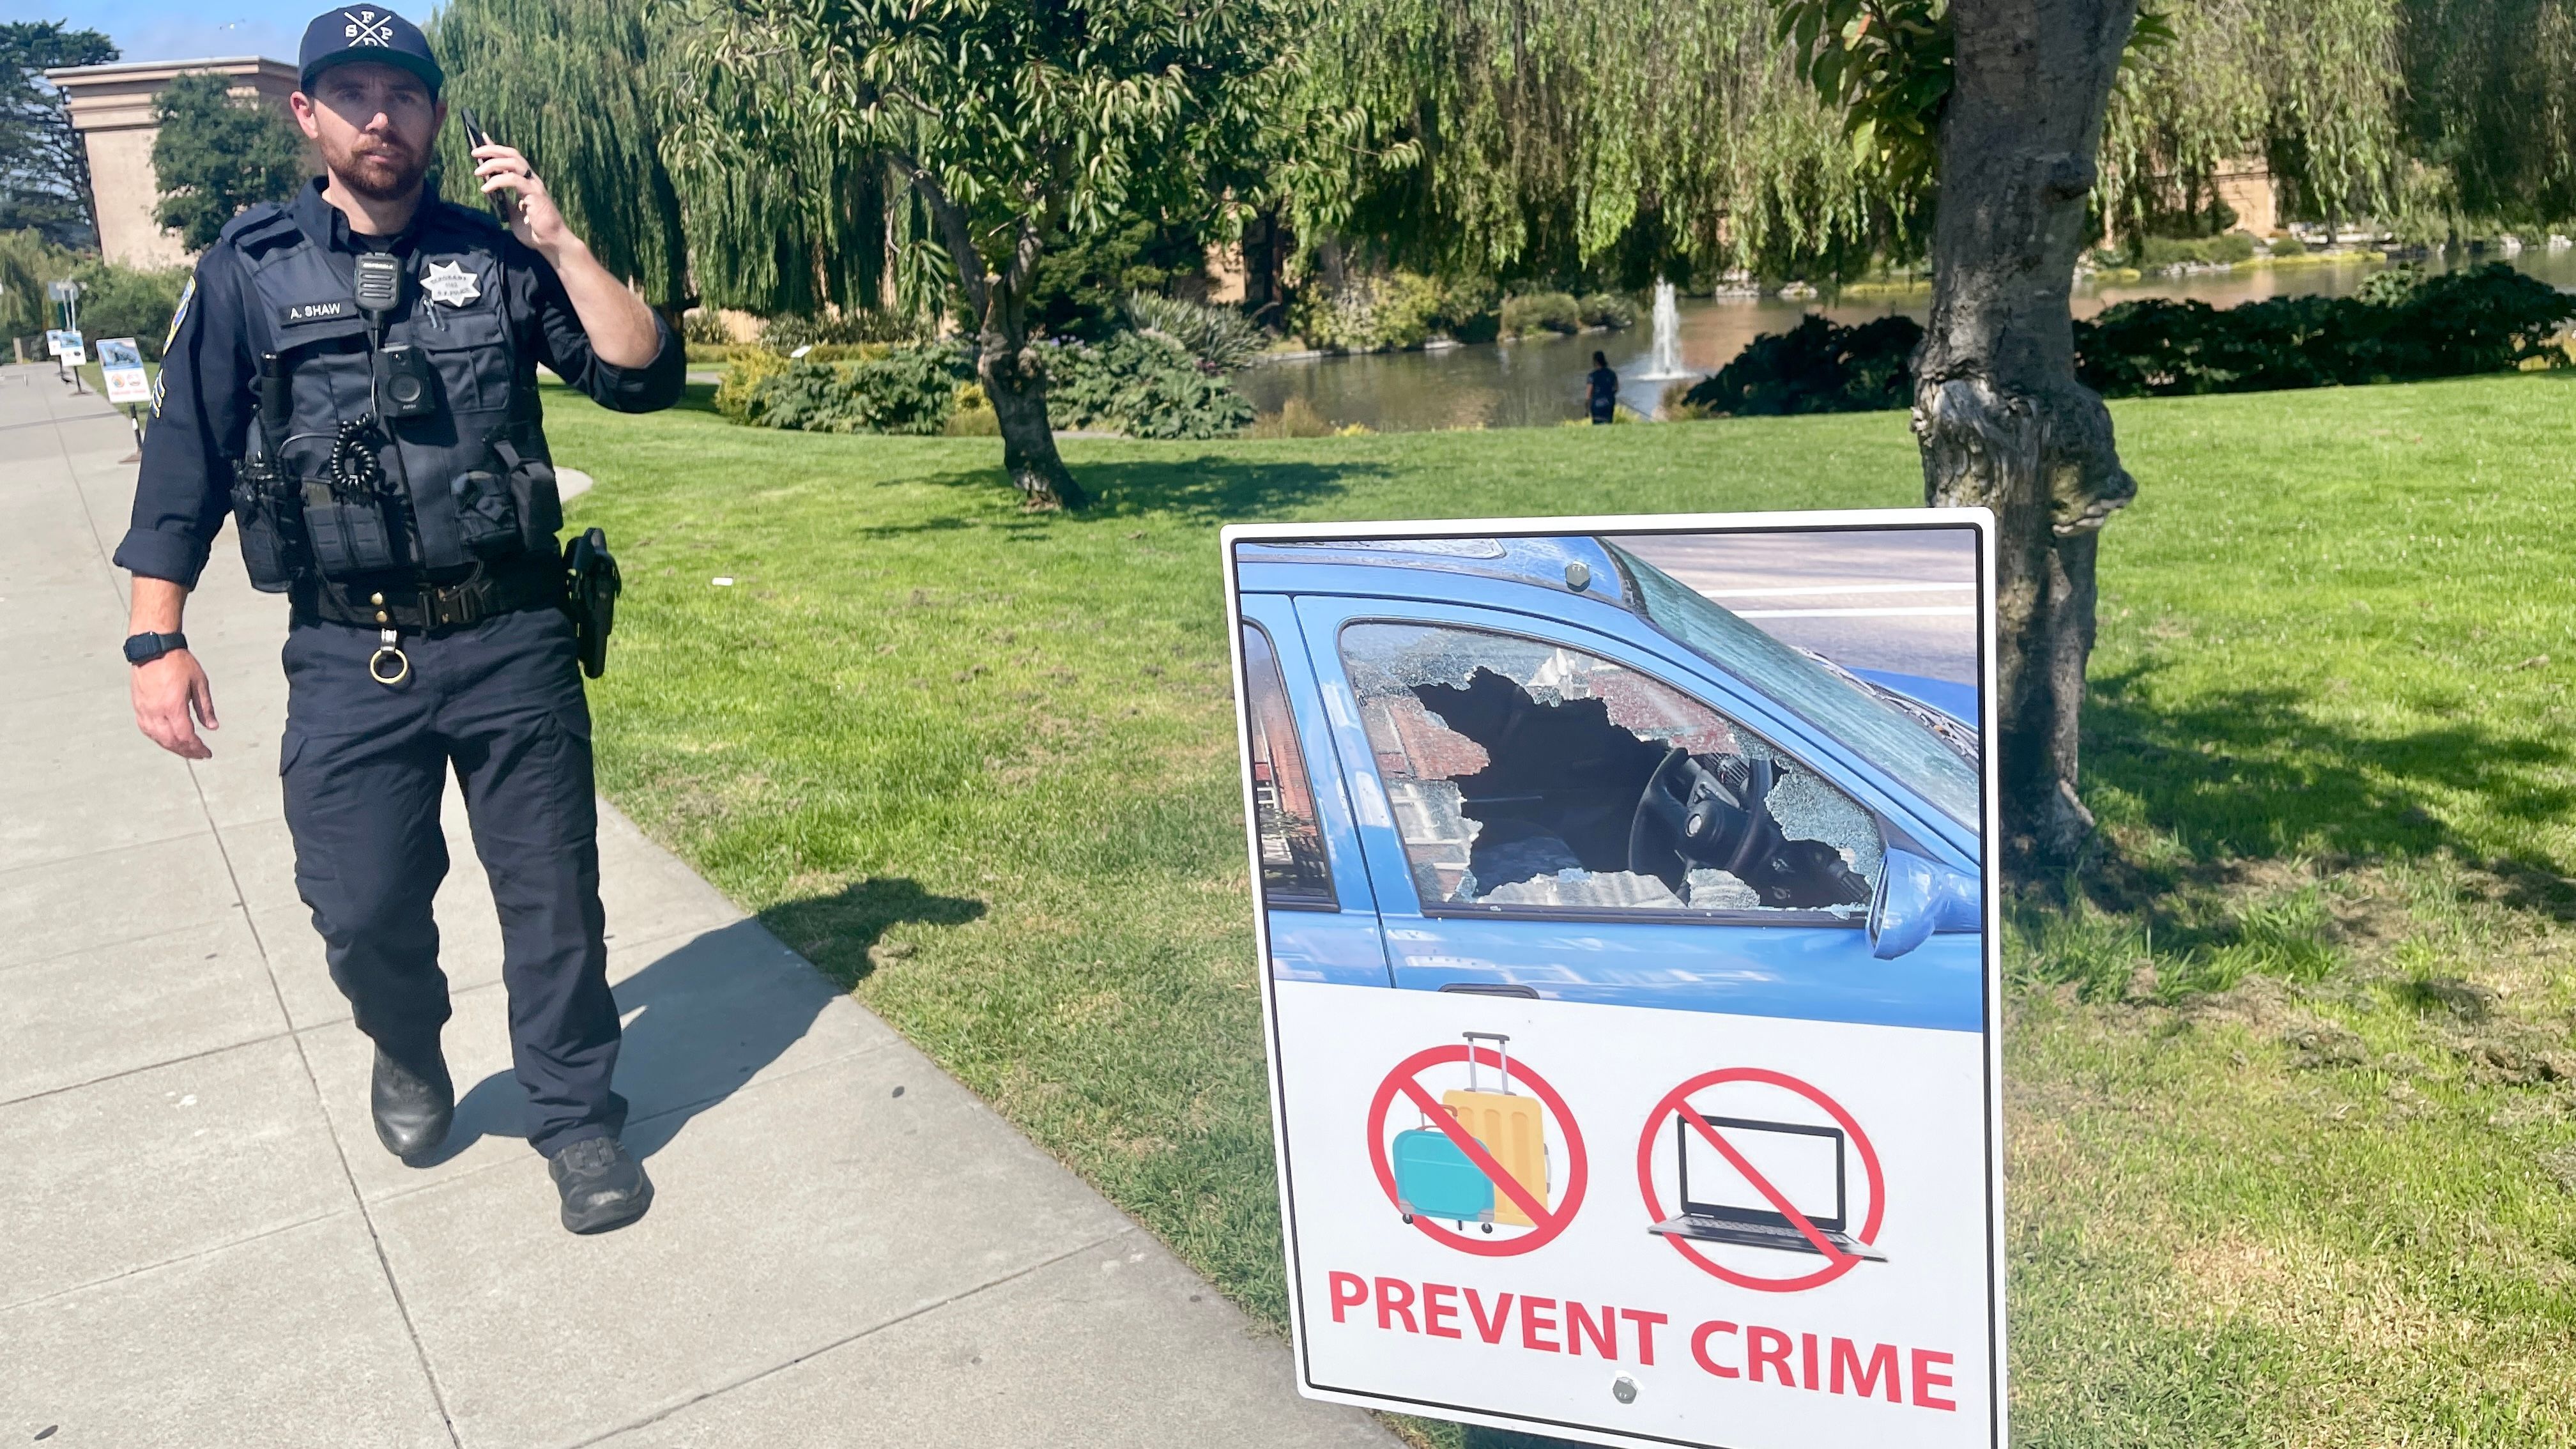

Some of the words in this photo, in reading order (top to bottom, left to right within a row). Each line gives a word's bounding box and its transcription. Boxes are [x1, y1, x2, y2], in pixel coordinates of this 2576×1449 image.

[290, 307, 302, 319] A.
[305, 302, 341, 317] SHAW
[1328, 1271, 1668, 1366] PREVENT
[1690, 1320, 1956, 1412] CRIME
